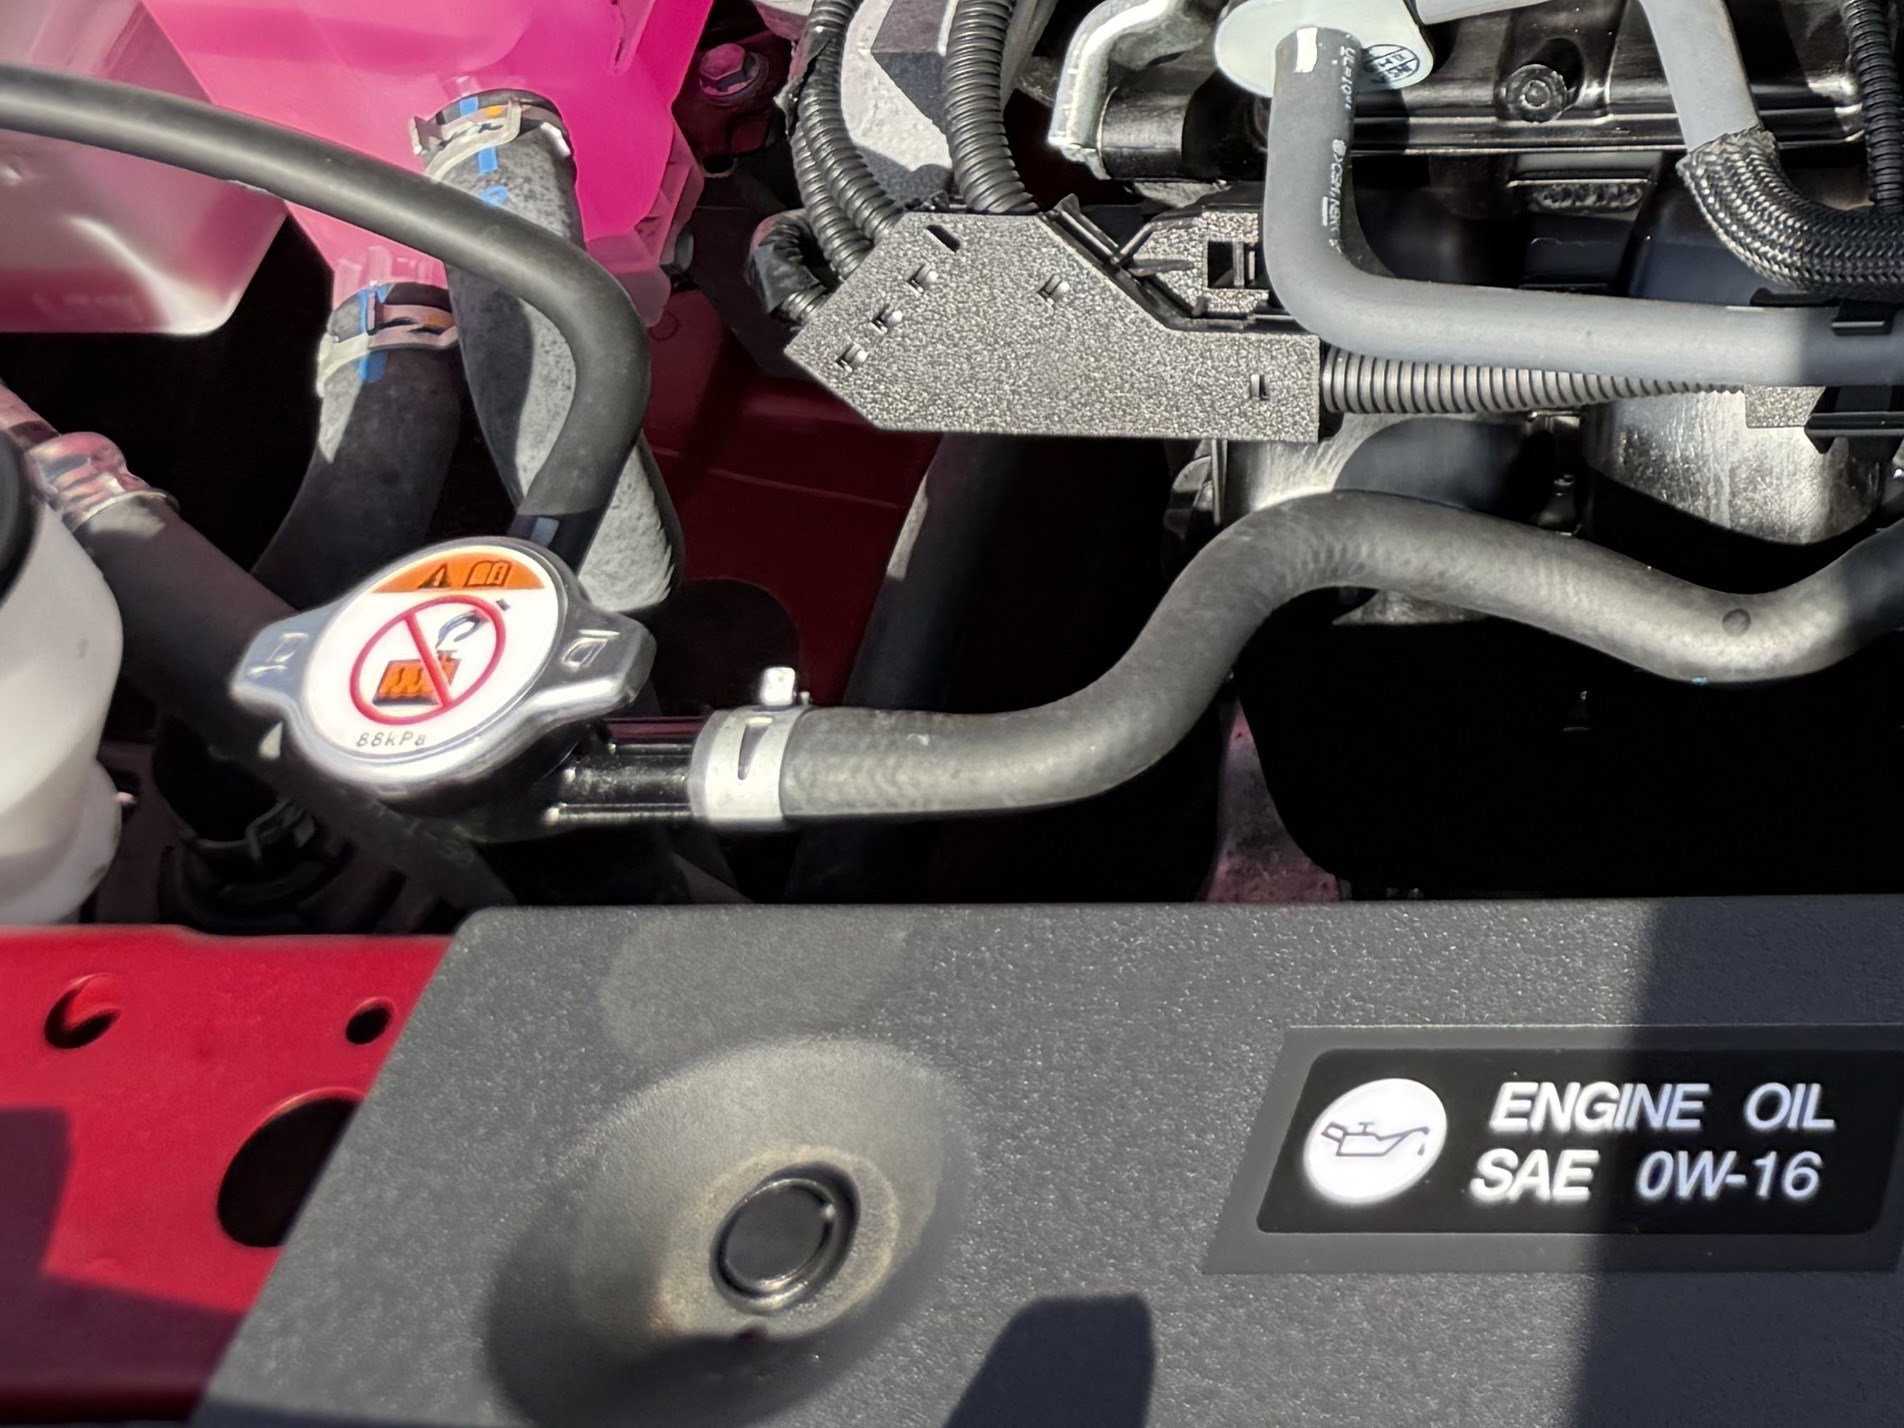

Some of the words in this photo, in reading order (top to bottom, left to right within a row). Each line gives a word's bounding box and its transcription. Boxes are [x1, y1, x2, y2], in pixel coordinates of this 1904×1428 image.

[355, 730, 427, 748] 88kPa
[1489, 1081, 1711, 1132] ENGINE
[1742, 1081, 1838, 1132] OIL
[1469, 1148, 1600, 1202] SAE
[1636, 1149, 1824, 1202] 0W-16
